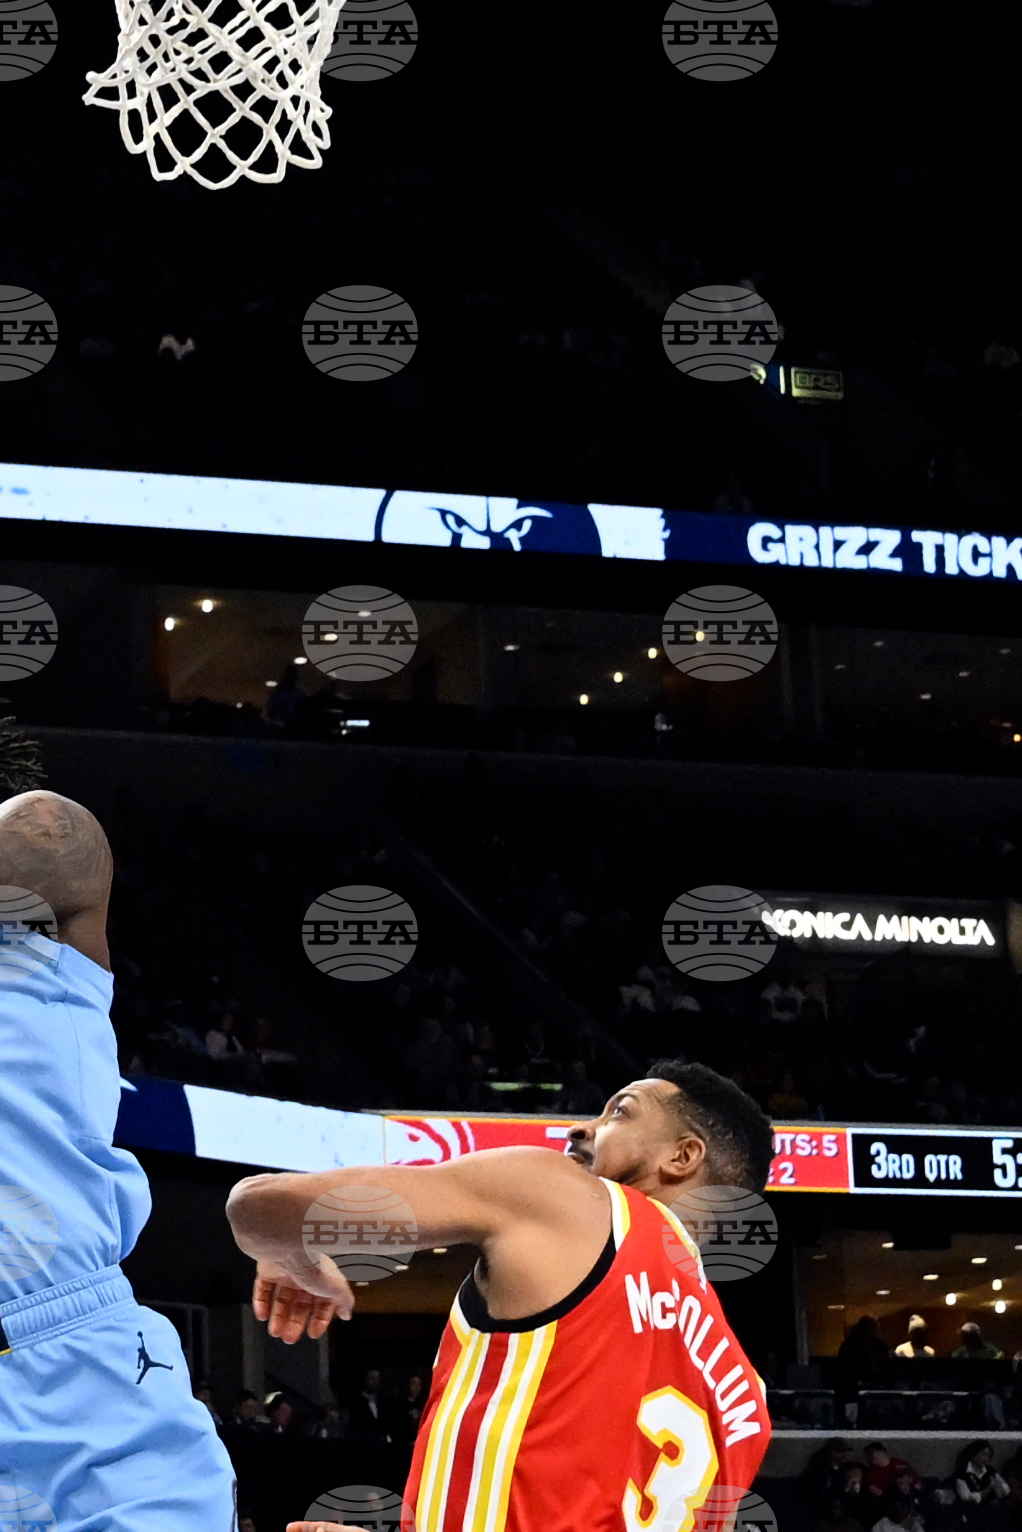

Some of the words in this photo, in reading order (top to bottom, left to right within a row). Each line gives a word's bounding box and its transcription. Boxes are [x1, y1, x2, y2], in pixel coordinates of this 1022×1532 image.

[747, 522, 903, 571] GRIZZ
[911, 530, 1022, 580] TICK
[762, 909, 873, 941] KONICA
[874, 914, 996, 946] MINOLTA
[822, 1134, 839, 1157] 5
[870, 1142, 915, 1179] 3RD
[924, 1154, 964, 1183] QTR
